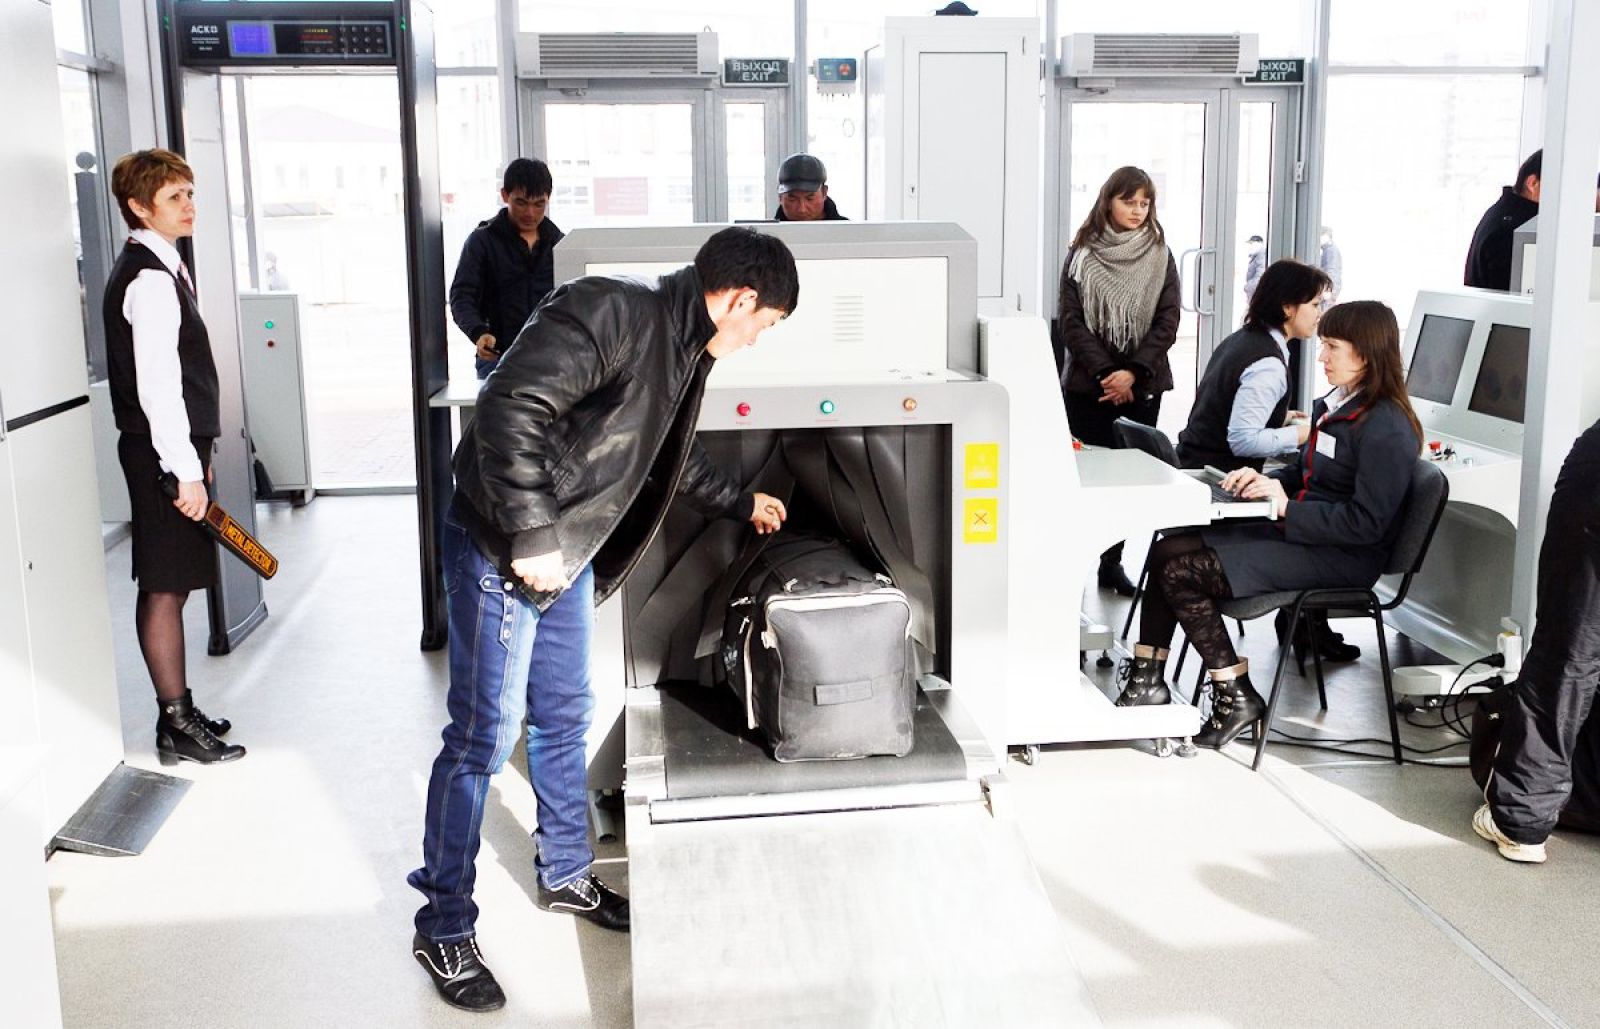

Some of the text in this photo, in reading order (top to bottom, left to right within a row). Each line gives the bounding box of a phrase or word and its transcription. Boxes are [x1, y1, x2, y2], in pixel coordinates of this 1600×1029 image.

[732, 61, 780, 72] ВЫХОД
[1259, 61, 1297, 72] ЫХОД
[742, 71, 769, 81] EXIT
[1261, 71, 1288, 81] EXIT
[224, 524, 272, 571] METAL DETECTOR
